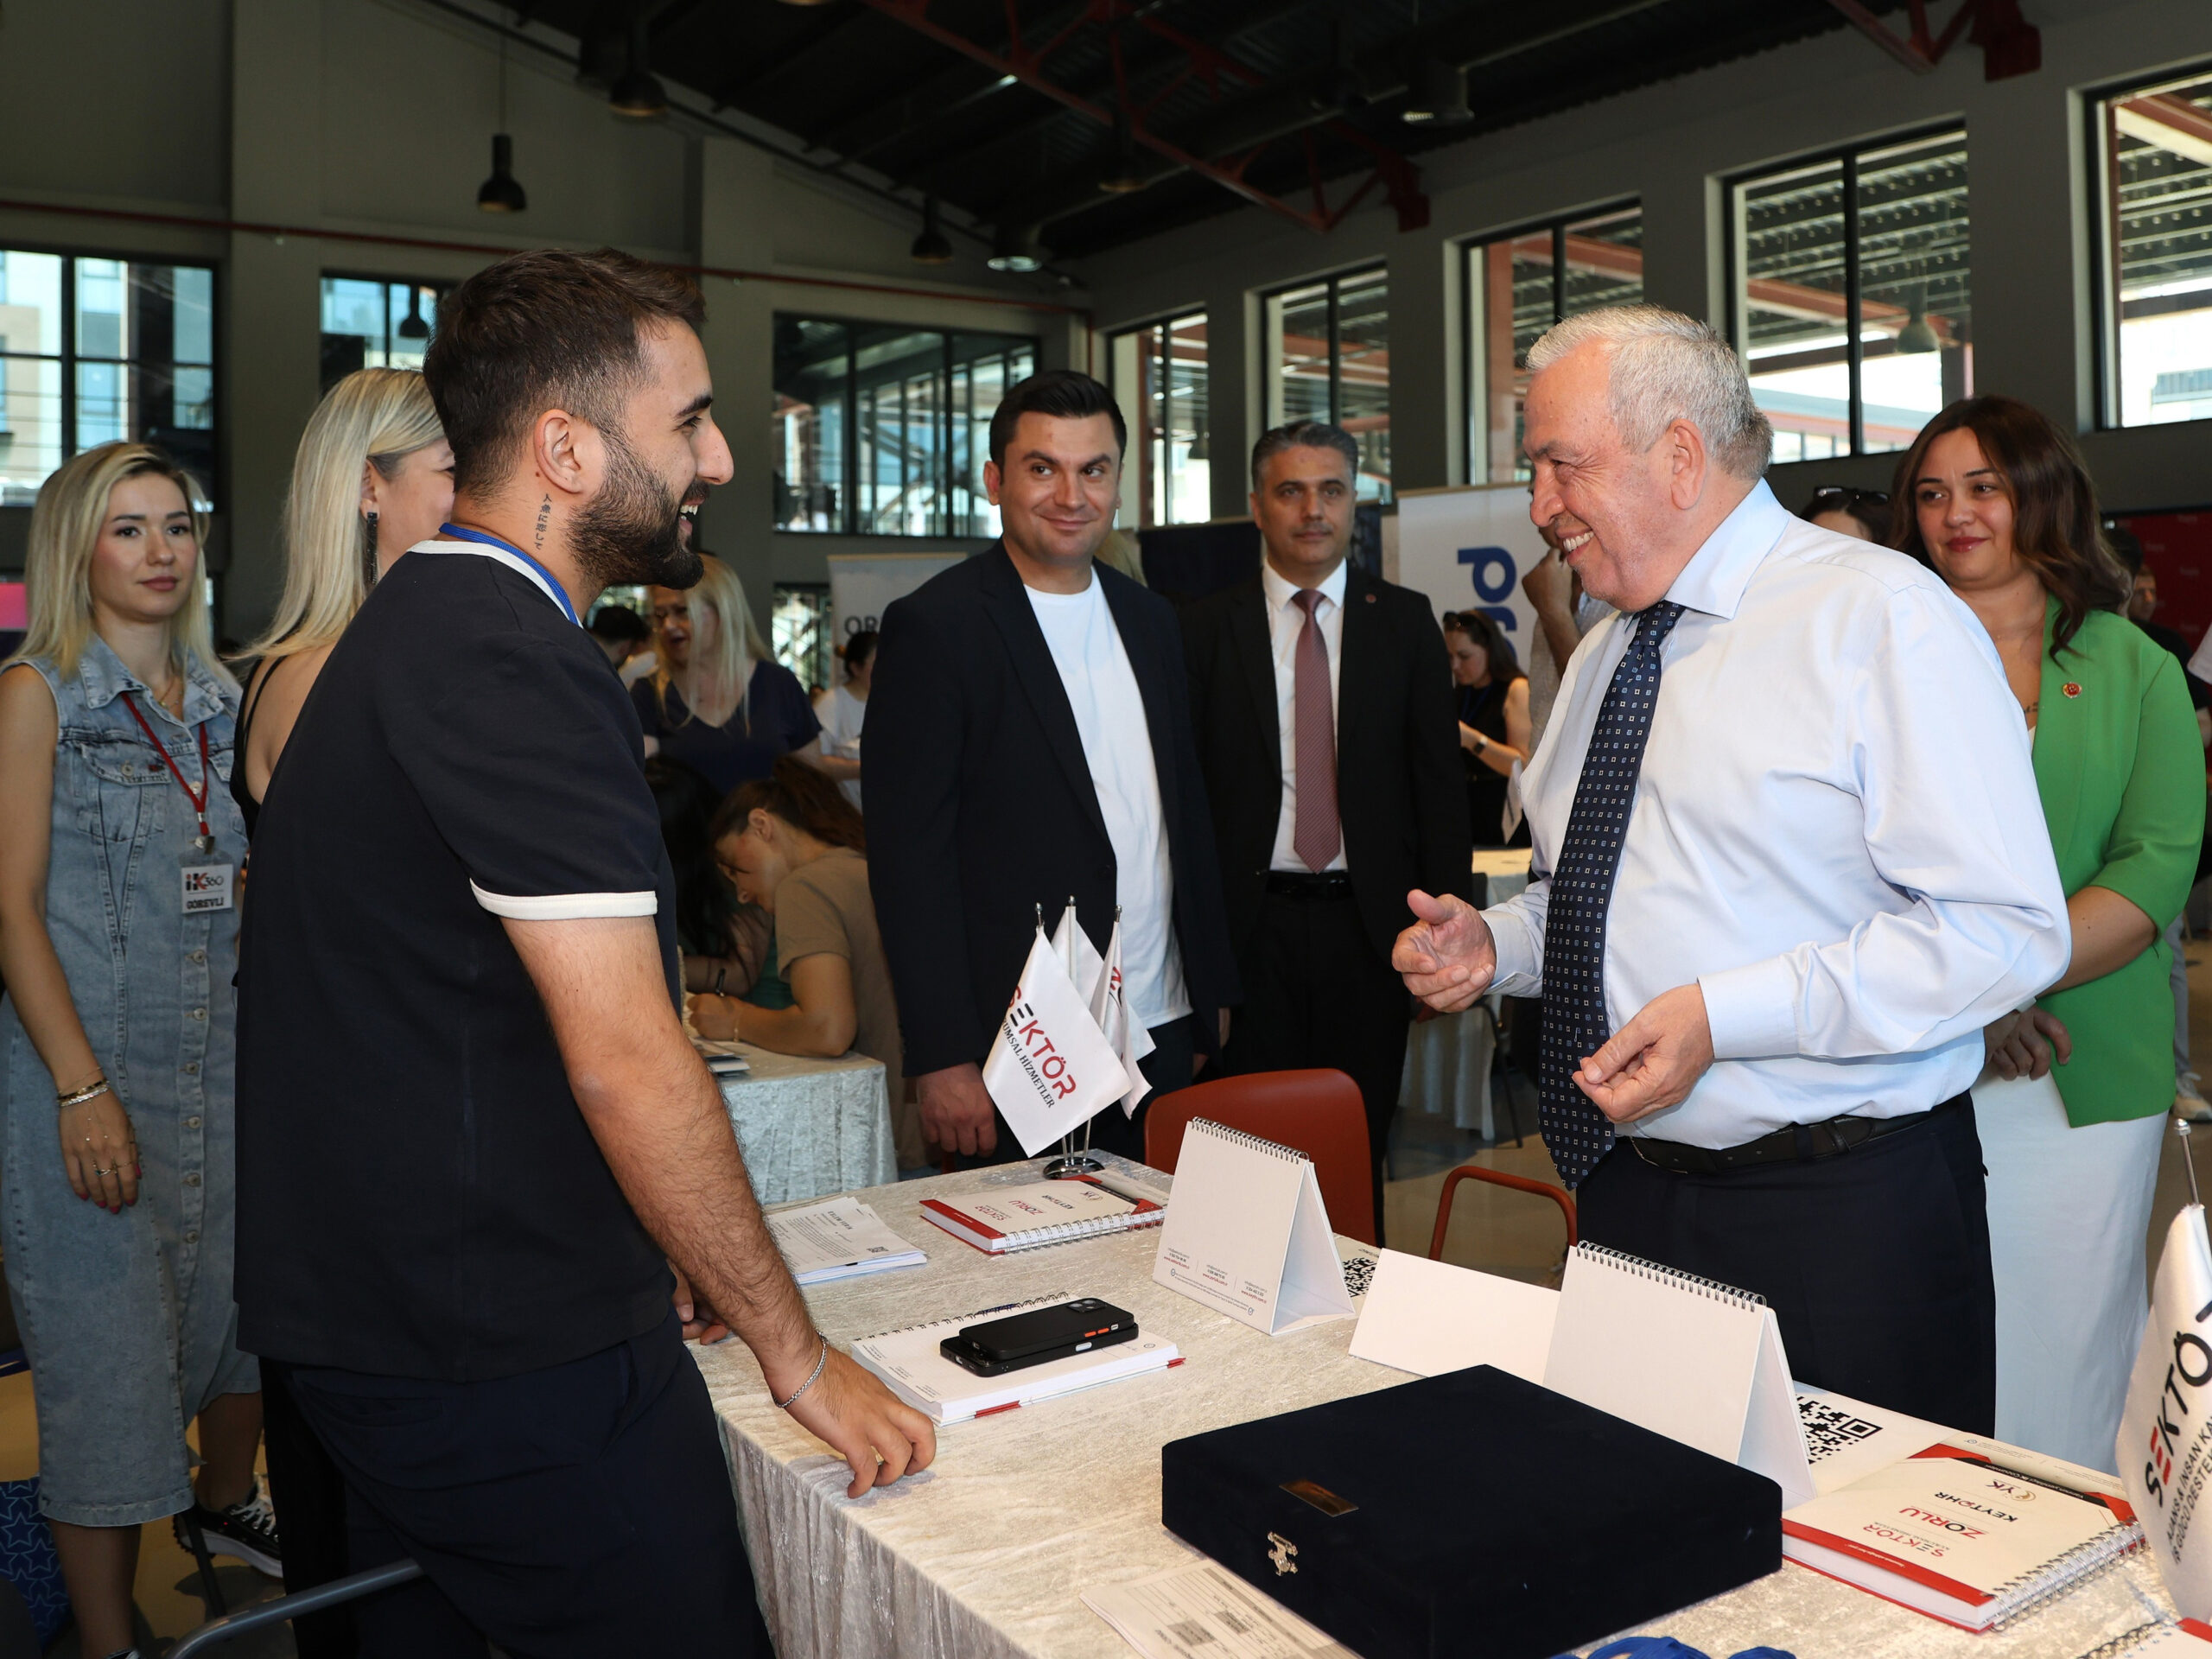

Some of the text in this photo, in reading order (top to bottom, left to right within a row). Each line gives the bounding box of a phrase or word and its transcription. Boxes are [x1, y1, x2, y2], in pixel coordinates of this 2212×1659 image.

[1019, 1054, 1056, 1109] HİZMETLER
[1008, 1199, 1044, 1216] ZORLU
[2145, 1299, 2212, 1509] SEKTÖ
[1986, 1480, 2014, 1494] YK
[1899, 1507, 1986, 1539] ZORLU
